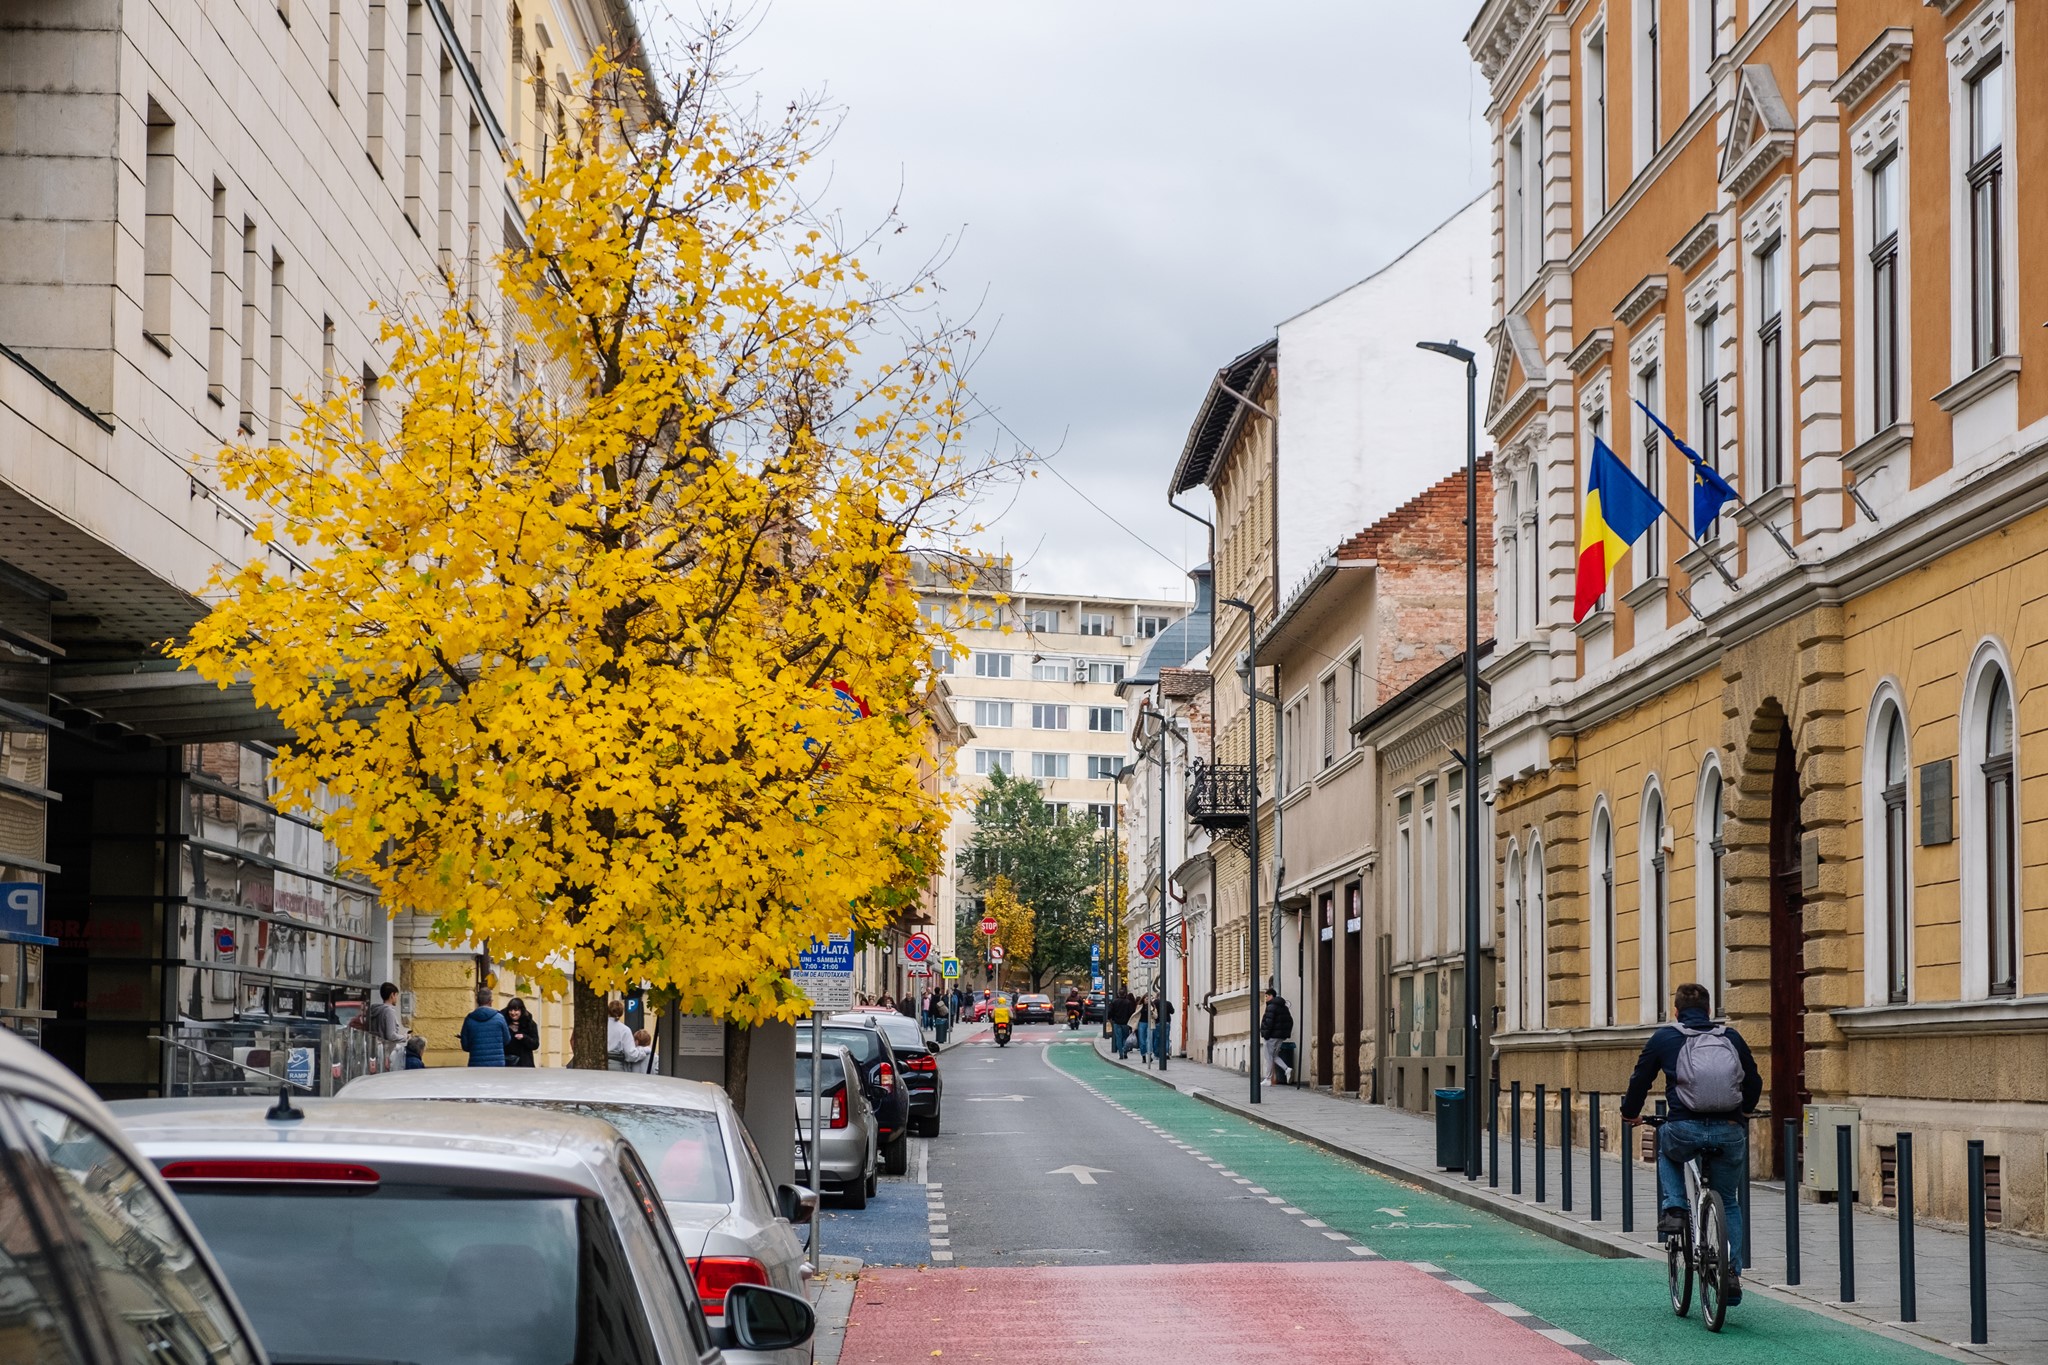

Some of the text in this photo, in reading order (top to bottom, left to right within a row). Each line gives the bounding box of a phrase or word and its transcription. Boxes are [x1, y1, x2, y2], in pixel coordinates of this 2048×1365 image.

[981, 922, 998, 930] STOP
[820, 943, 849, 954] PLATĂ
[628, 999, 636, 1010] P
